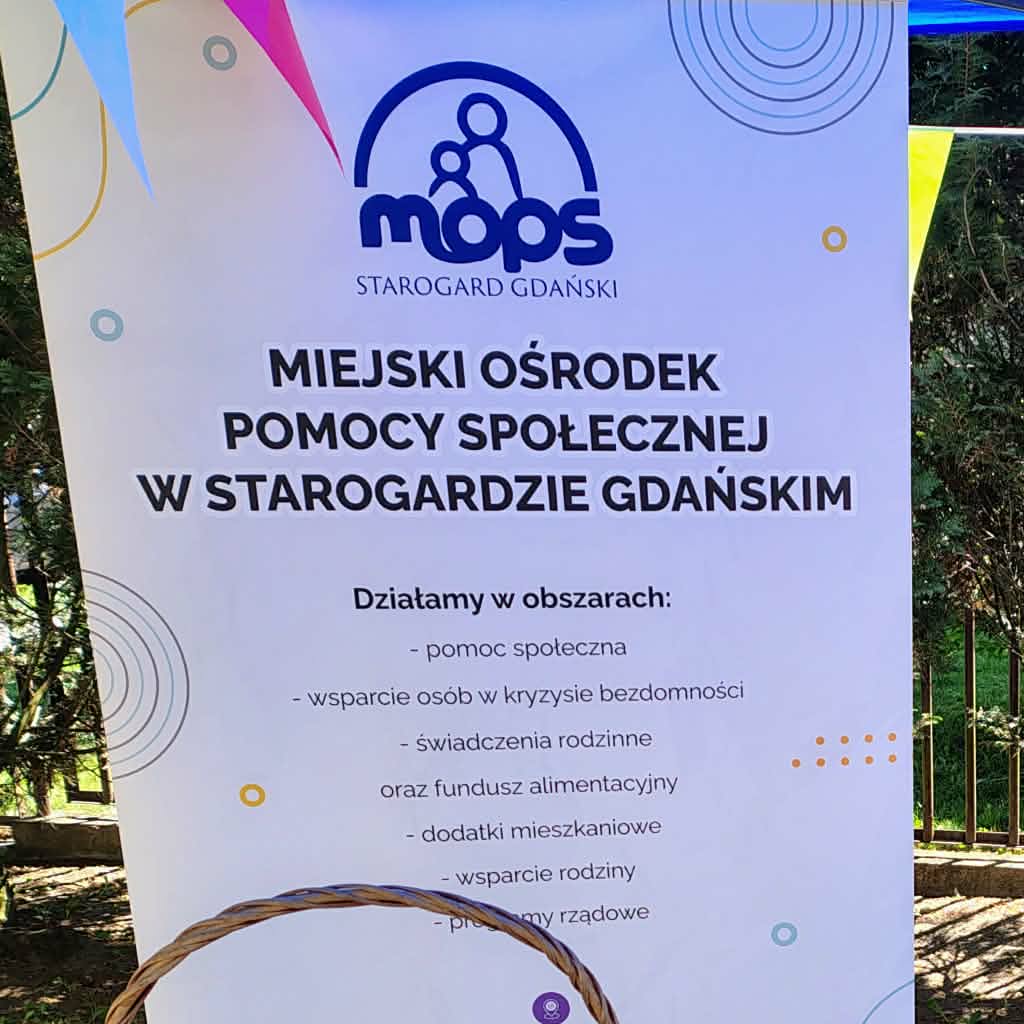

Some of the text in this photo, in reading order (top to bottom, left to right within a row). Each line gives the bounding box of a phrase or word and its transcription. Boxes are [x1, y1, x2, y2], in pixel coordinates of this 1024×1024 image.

[359, 194, 613, 273] mops
[357, 275, 618, 299] STAROGARD GDAŃSKI
[269, 340, 720, 392] MIEJSKI OŚRODEK
[223, 412, 768, 453] POMOCY SPOŁECZNEJ
[136, 466, 852, 512] W STAROGARDZIE GDAŃSKIM
[353, 586, 672, 615] Działamy w obszarach:
[426, 642, 507, 662] pomoc
[513, 637, 627, 662] społeczna
[307, 687, 411, 711] wsparcie
[417, 685, 473, 706] osób
[478, 689, 498, 705] w
[503, 683, 593, 709] kryzysie
[599, 680, 744, 703] bezdomności
[416, 730, 552, 752] świadczenia
[558, 728, 653, 750] rodzinne
[380, 771, 679, 799] oraz fundusz alimentacyjny
[421, 821, 504, 843] dodatki
[511, 818, 662, 840] mieszkaniowe
[455, 865, 553, 889] wsparcie
[559, 861, 636, 886] rodziny
[560, 904, 650, 926] rządowe
